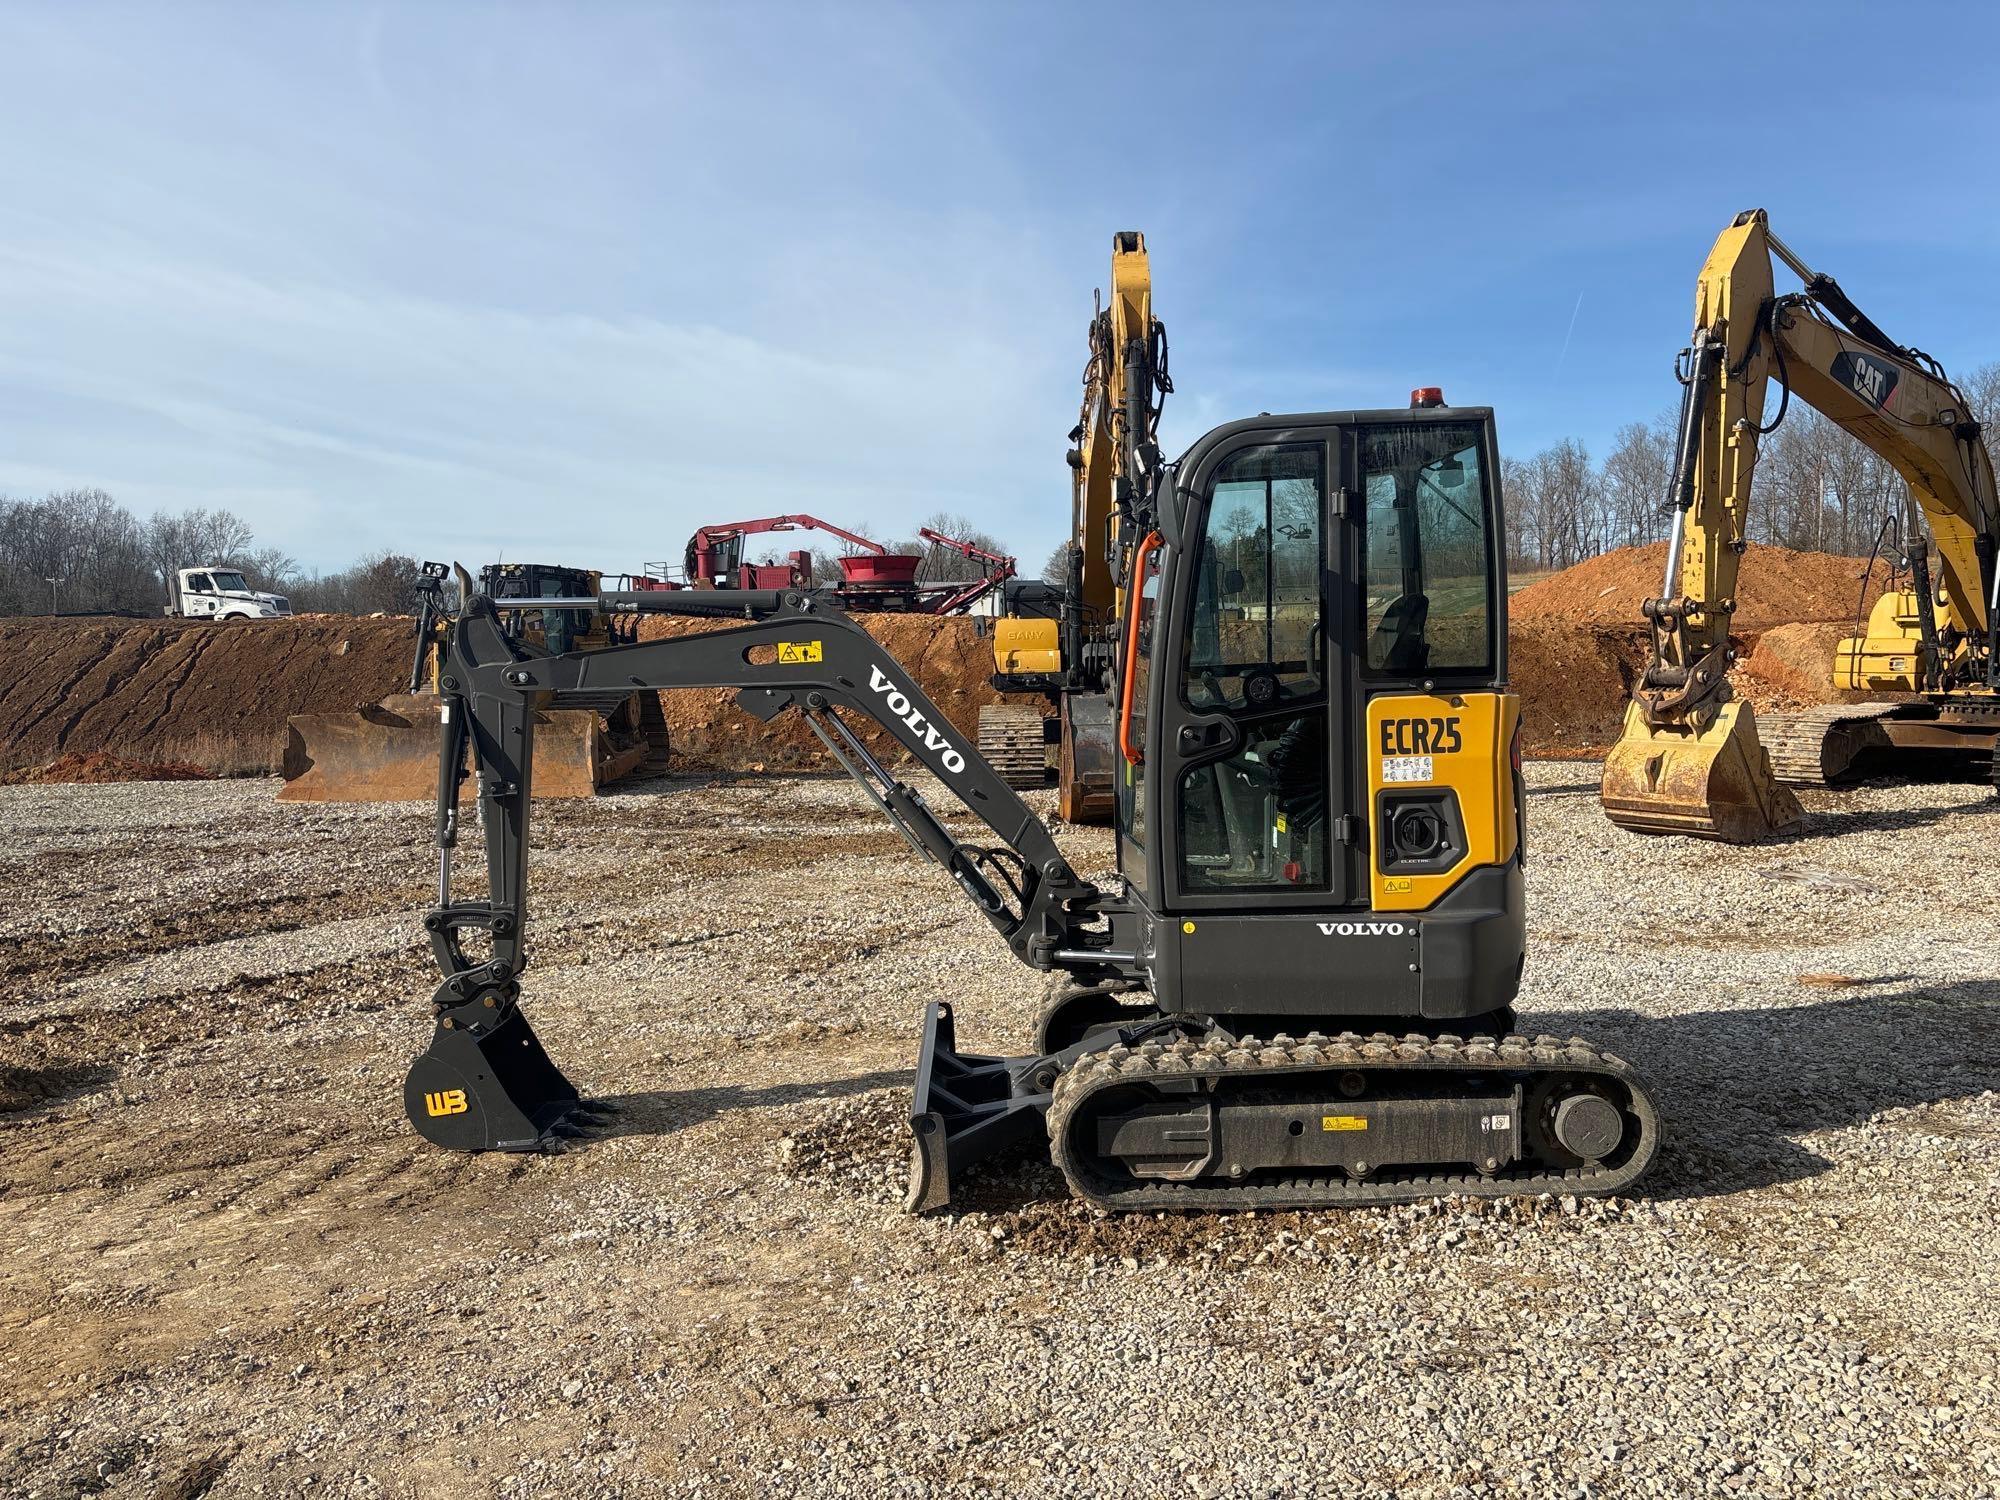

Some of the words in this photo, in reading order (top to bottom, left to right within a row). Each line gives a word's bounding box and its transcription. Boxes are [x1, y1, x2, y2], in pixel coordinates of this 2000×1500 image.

[1853, 357, 1883, 405] CAT
[1008, 631, 1044, 640] SANY
[869, 664, 966, 774] VOLVO
[1381, 717, 1462, 755] ECR25
[1316, 923, 1404, 936] VOLVO
